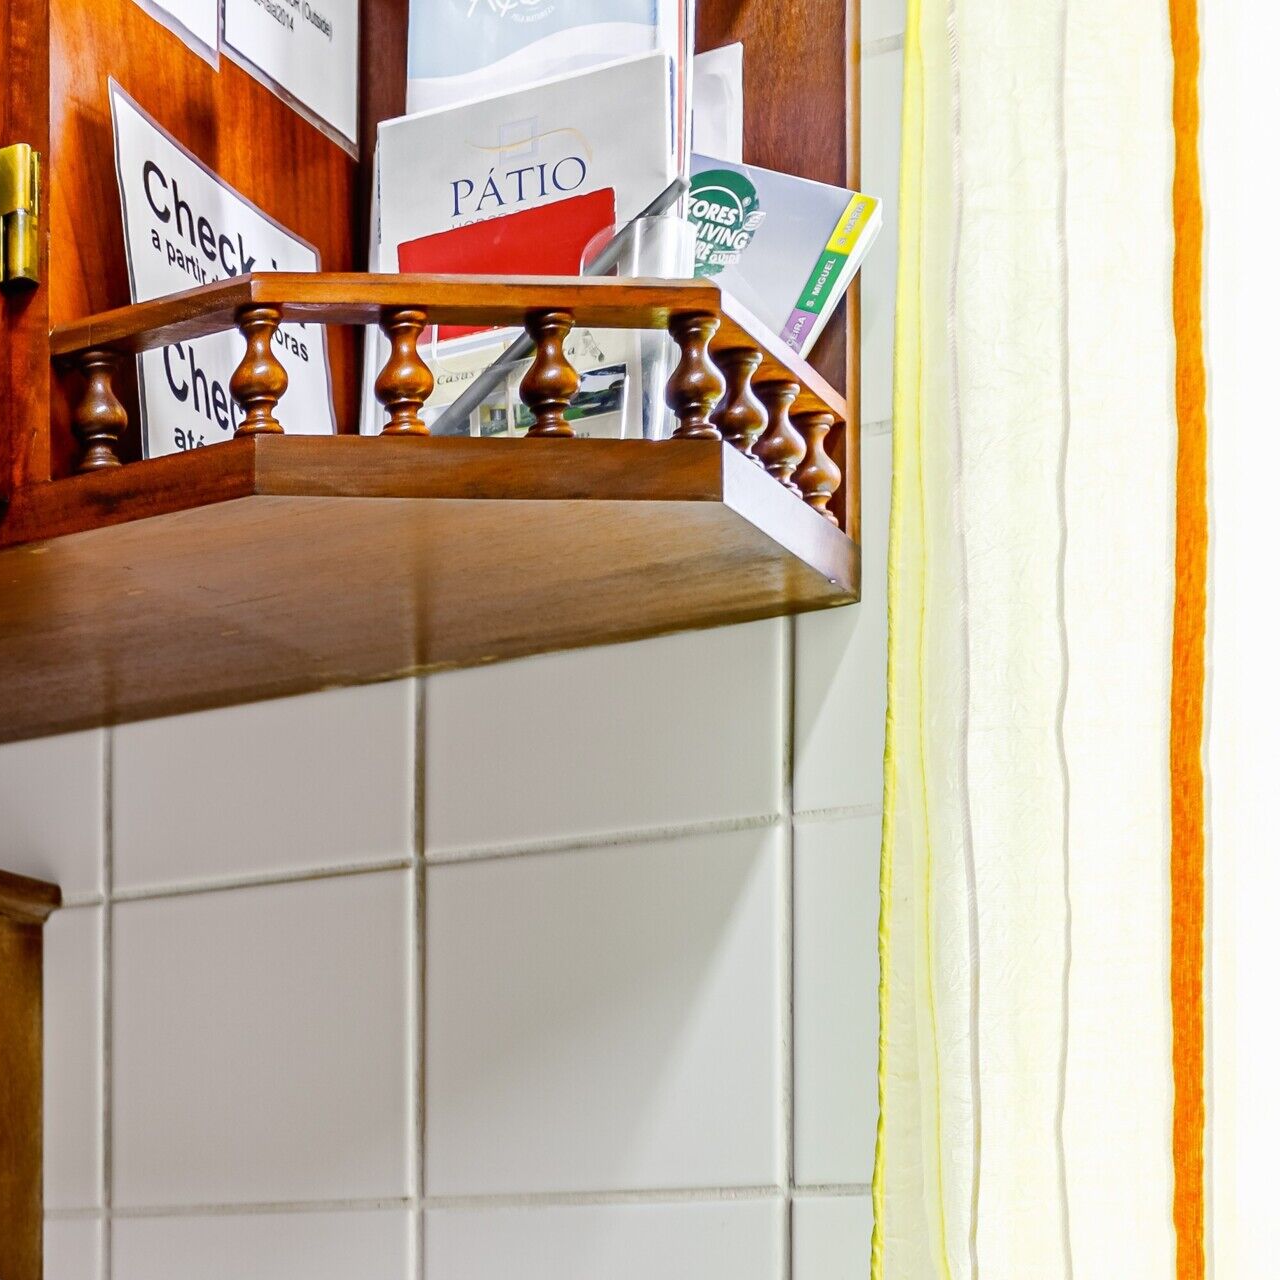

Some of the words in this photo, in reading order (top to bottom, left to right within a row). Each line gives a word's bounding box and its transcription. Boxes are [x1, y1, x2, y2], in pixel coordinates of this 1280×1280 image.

[451, 156, 587, 217] PÁTIO
[150, 228, 161, 252] a
[811, 258, 837, 297] MIGUEL
[787, 316, 807, 347] CEIRA
